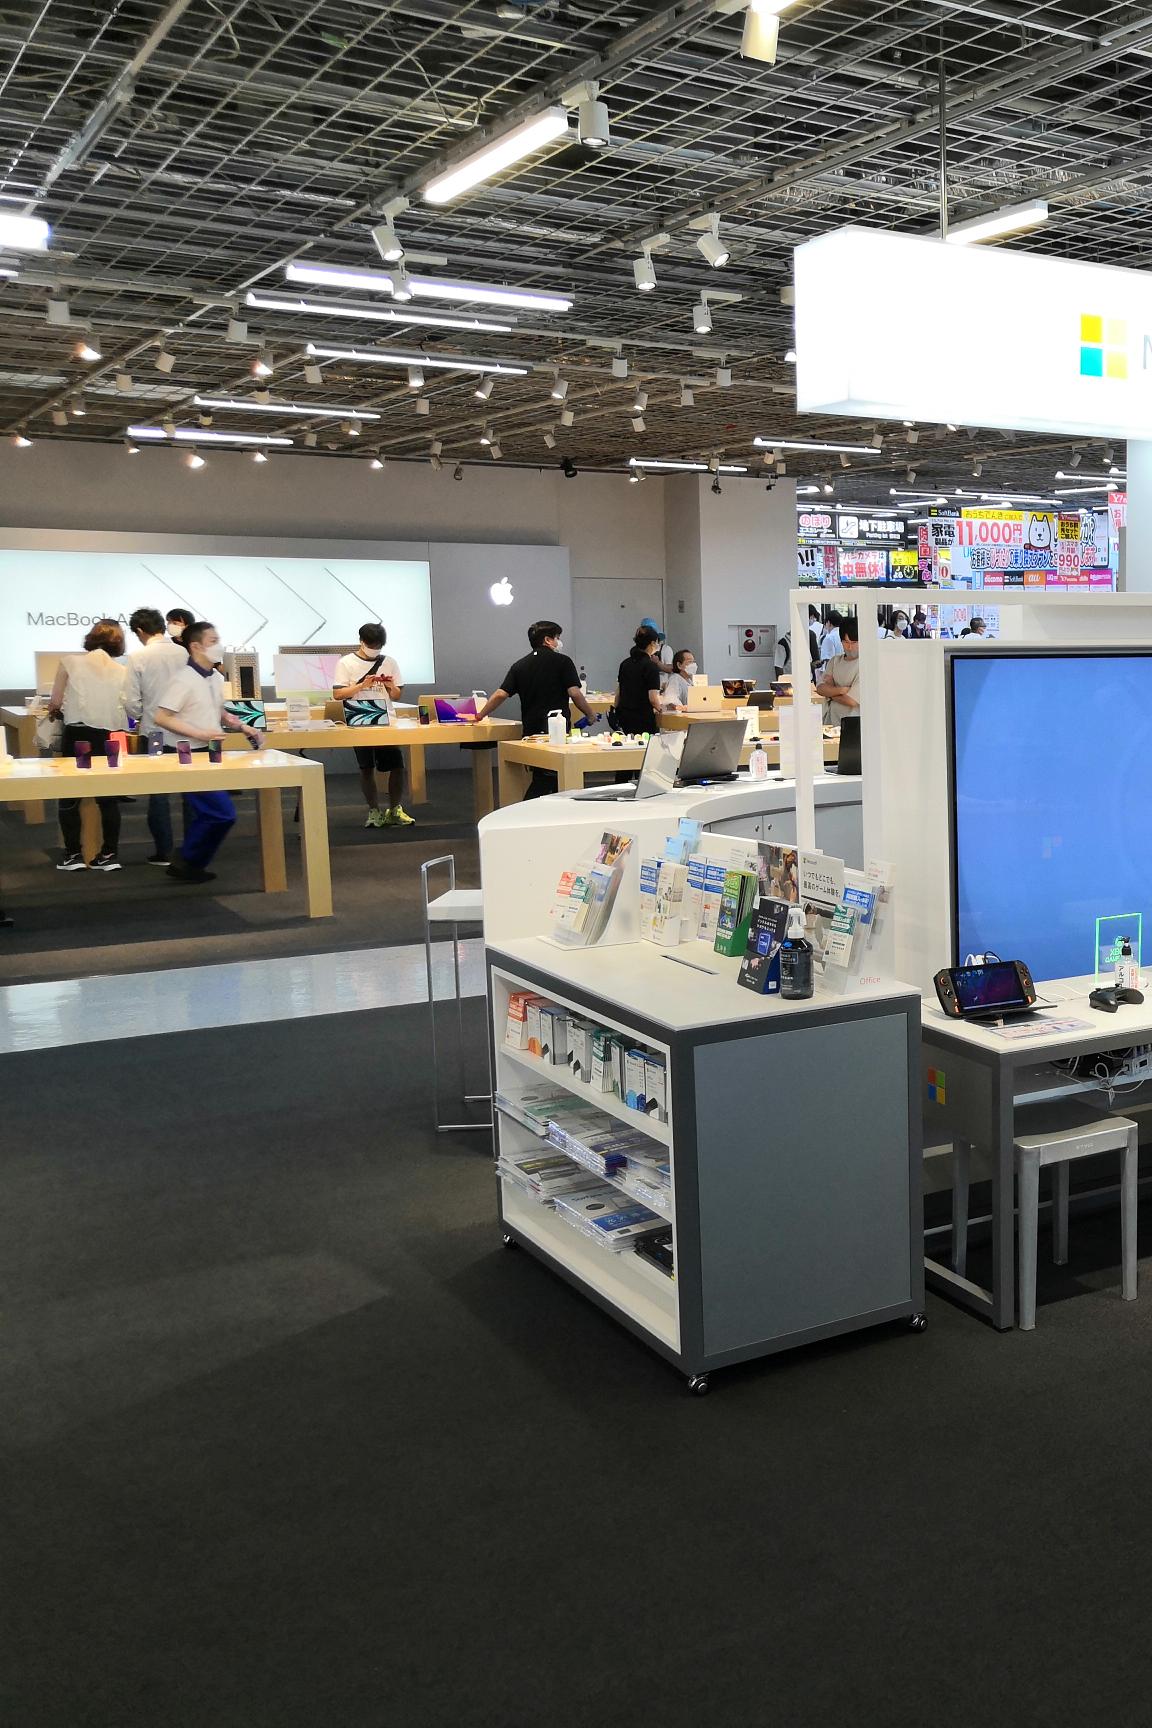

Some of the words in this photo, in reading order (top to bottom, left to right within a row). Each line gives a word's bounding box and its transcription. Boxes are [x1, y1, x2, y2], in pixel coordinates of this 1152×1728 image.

[937, 509, 960, 517] SoftBank
[799, 513, 832, 528] のぼり
[931, 523, 956, 538] 家電
[1058, 554, 1080, 567] 990
[860, 977, 881, 985] Office
